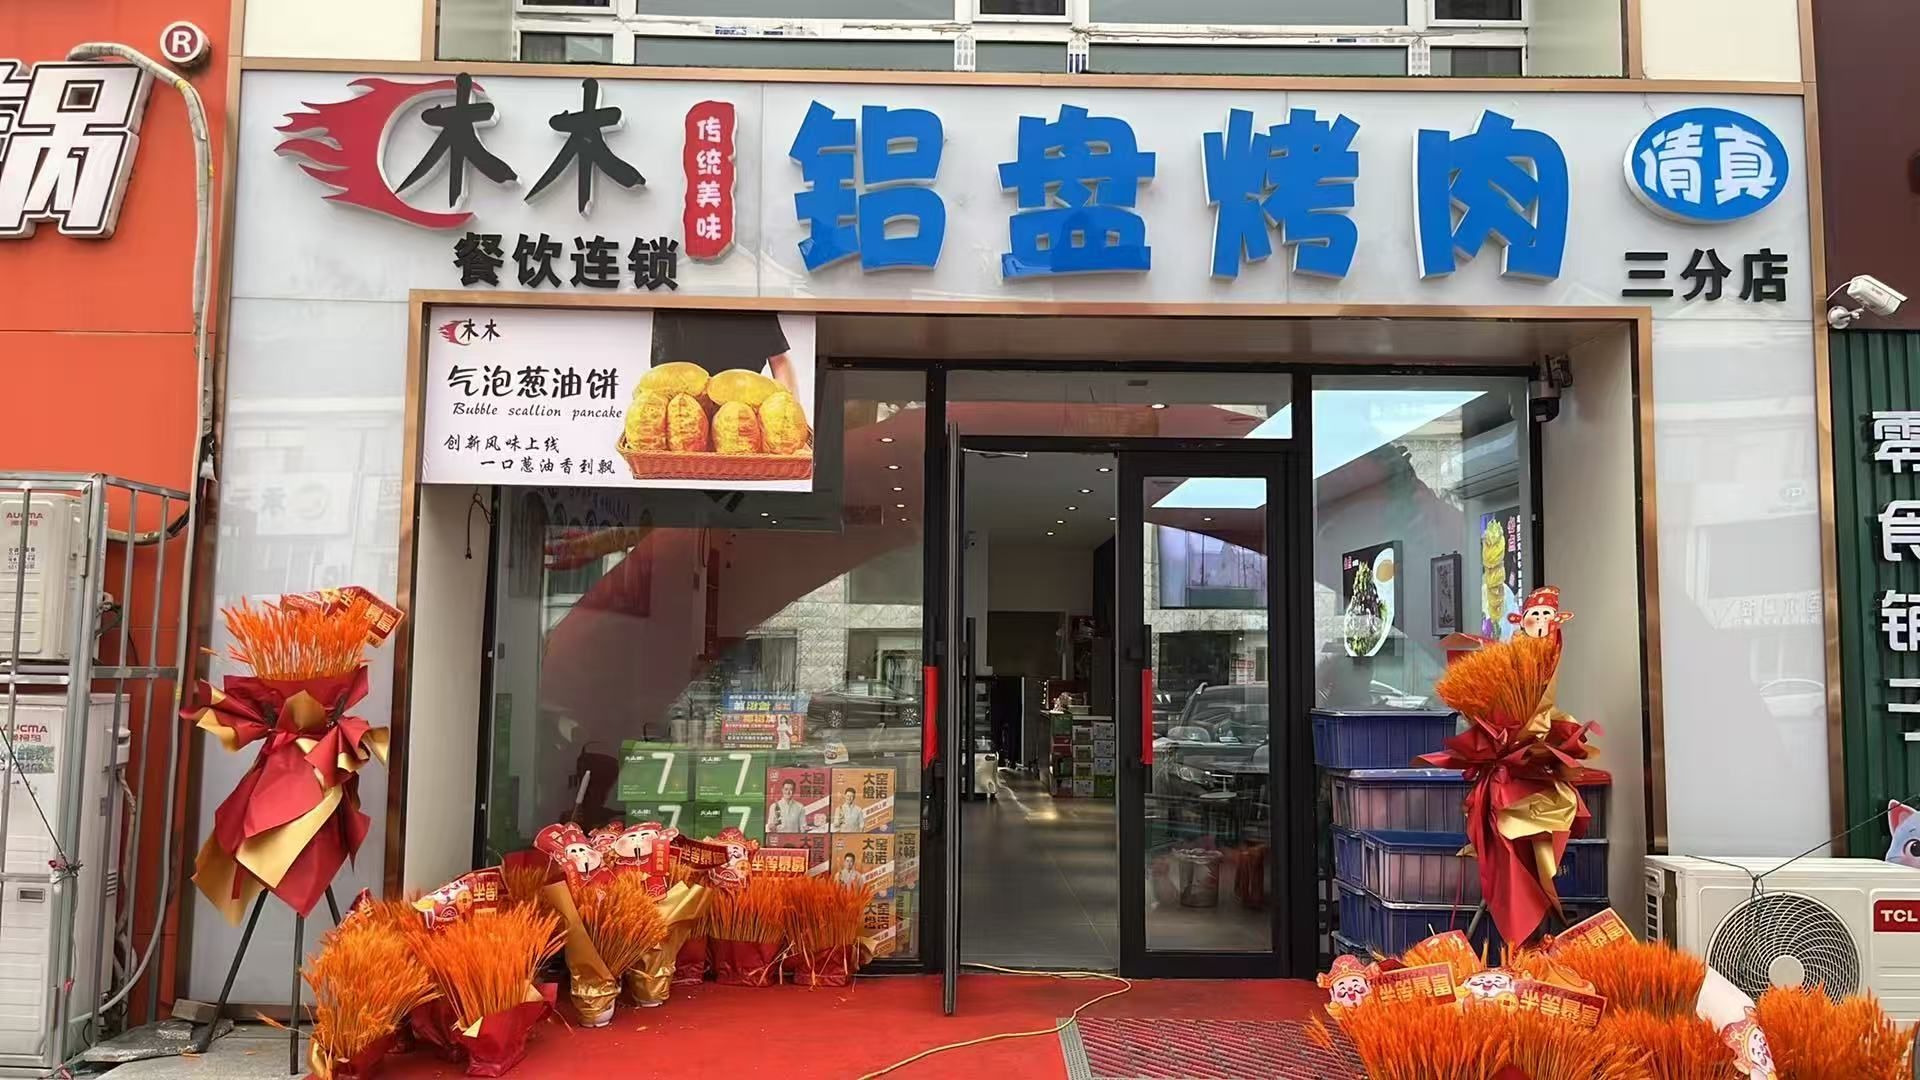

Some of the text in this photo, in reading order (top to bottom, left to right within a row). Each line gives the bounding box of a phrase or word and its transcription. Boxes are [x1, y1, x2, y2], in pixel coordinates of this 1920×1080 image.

[394, 72, 646, 217] 木木
[696, 116, 722, 240] 传统美味
[1641, 122, 1777, 206] 清真
[789, 100, 1571, 281] 铝盘烤肉
[453, 231, 679, 291] 餐饮连锁
[1622, 247, 1788, 303] 三分店
[459, 318, 501, 342] 木木
[447, 364, 620, 400] 气泡葱油饼
[452, 402, 623, 421] Bubble scallion pancake
[444, 434, 560, 454] 创新风味上线
[480, 457, 616, 475] 一口葱油香到飘
[6, 511, 44, 520] AUMA
[652, 752, 675, 794] 7
[728, 753, 752, 795] 7
[658, 805, 682, 829] 7
[728, 806, 752, 835] 7
[1880, 909, 1919, 922] TCL
